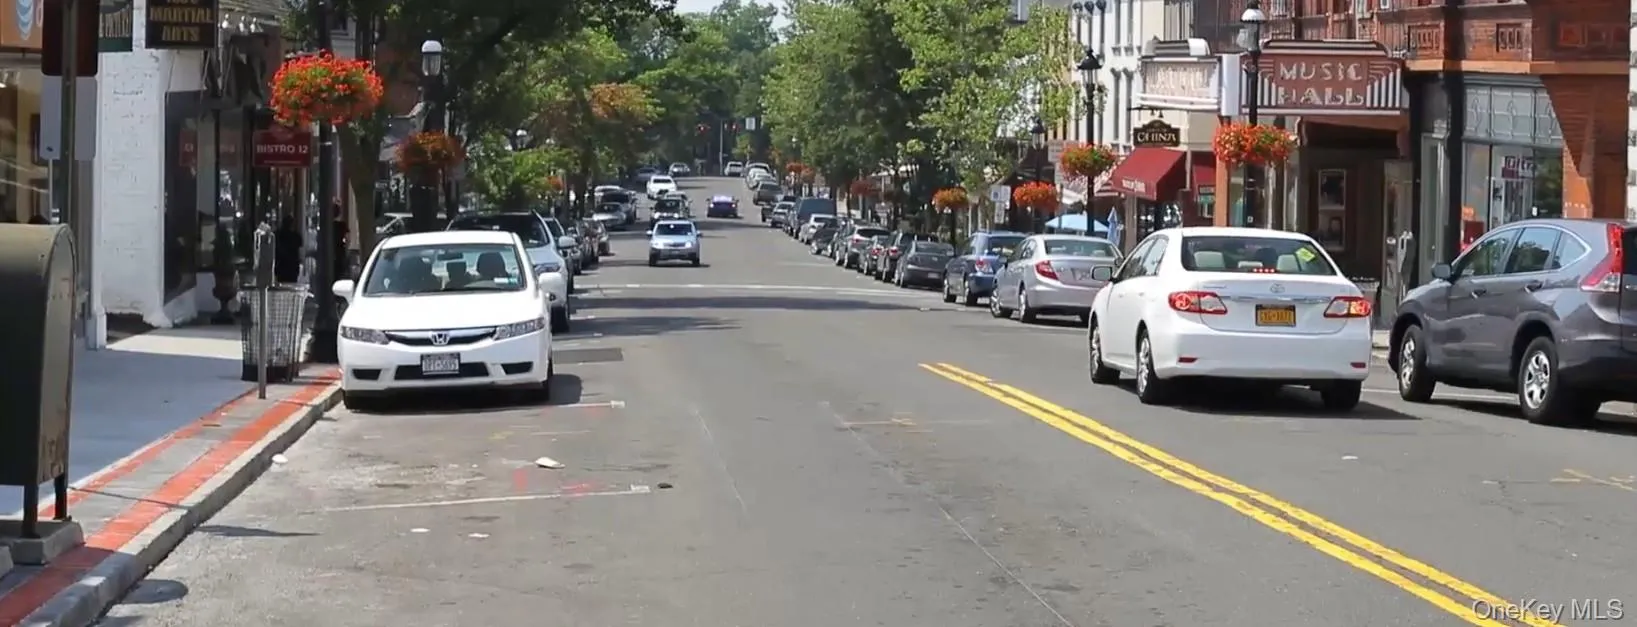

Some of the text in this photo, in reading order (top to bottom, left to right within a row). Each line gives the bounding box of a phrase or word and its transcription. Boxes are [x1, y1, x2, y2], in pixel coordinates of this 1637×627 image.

[149, 7, 214, 23] MARTIAL
[161, 26, 200, 41] ARTS
[1279, 62, 1363, 81] MUSIC
[1277, 86, 1365, 106] HALL
[1137, 131, 1177, 143] CHINA
[256, 143, 309, 154] BISTRO 12
